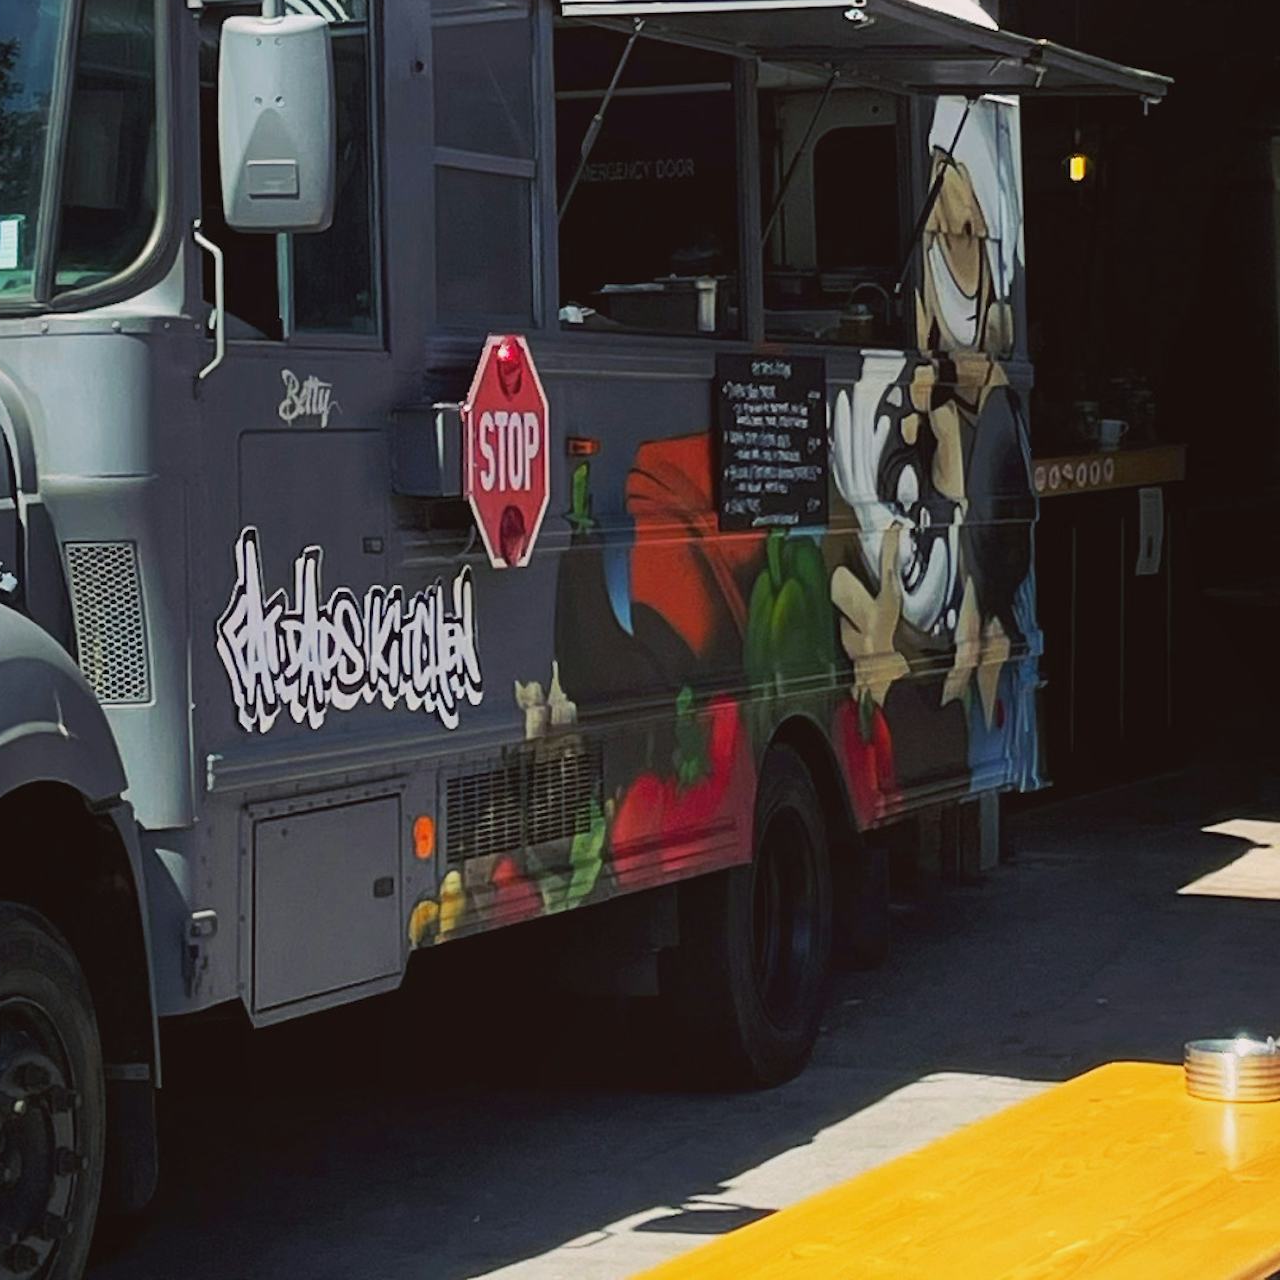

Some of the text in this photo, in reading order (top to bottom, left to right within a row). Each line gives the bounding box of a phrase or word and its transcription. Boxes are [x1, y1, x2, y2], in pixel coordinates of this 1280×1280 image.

[571, 157, 696, 183] MERGENCY DOOR
[478, 410, 540, 493] STOP
